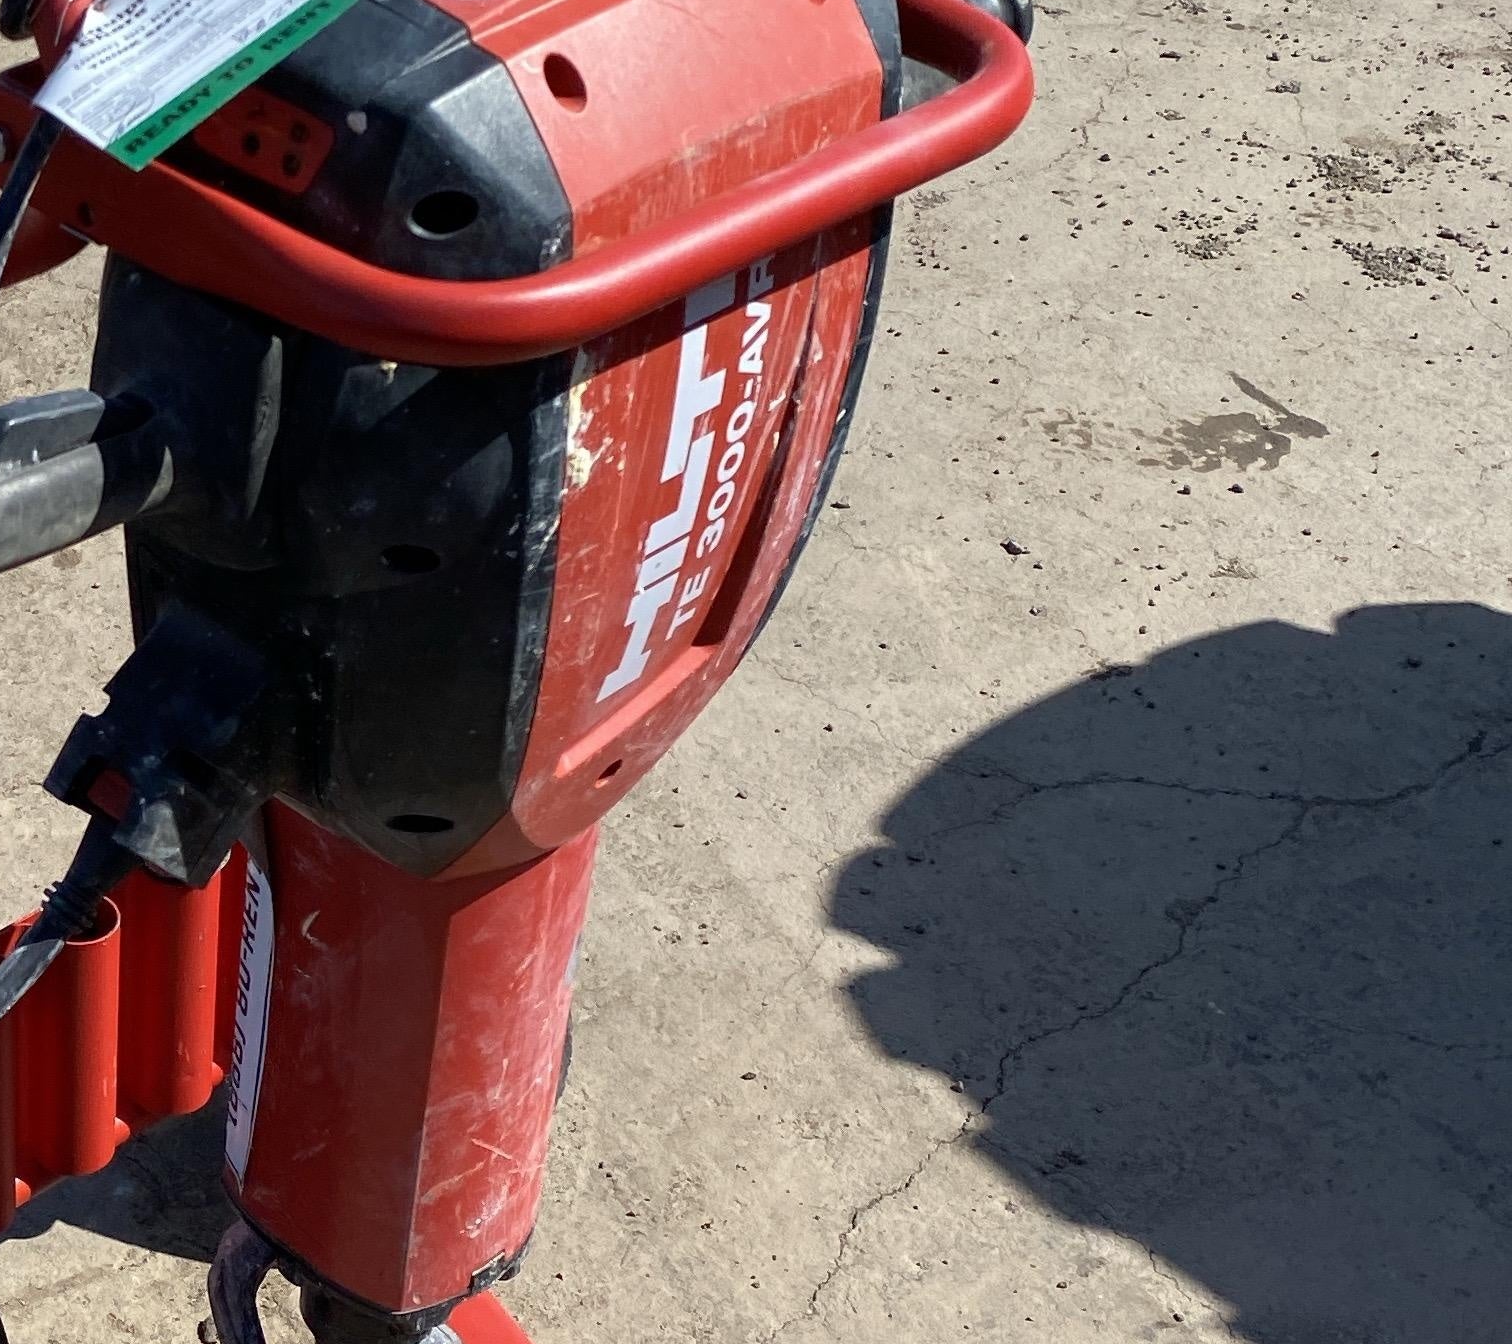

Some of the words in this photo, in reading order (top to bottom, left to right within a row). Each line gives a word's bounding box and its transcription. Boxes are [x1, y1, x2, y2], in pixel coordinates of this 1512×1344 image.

[123, 84, 211, 153] READY
[218, 56, 255, 82] TO
[260, 0, 331, 51] RENT
[595, 270, 736, 704] HILTI
[665, 564, 712, 641] TE
[694, 253, 777, 560] 3000-AVR
